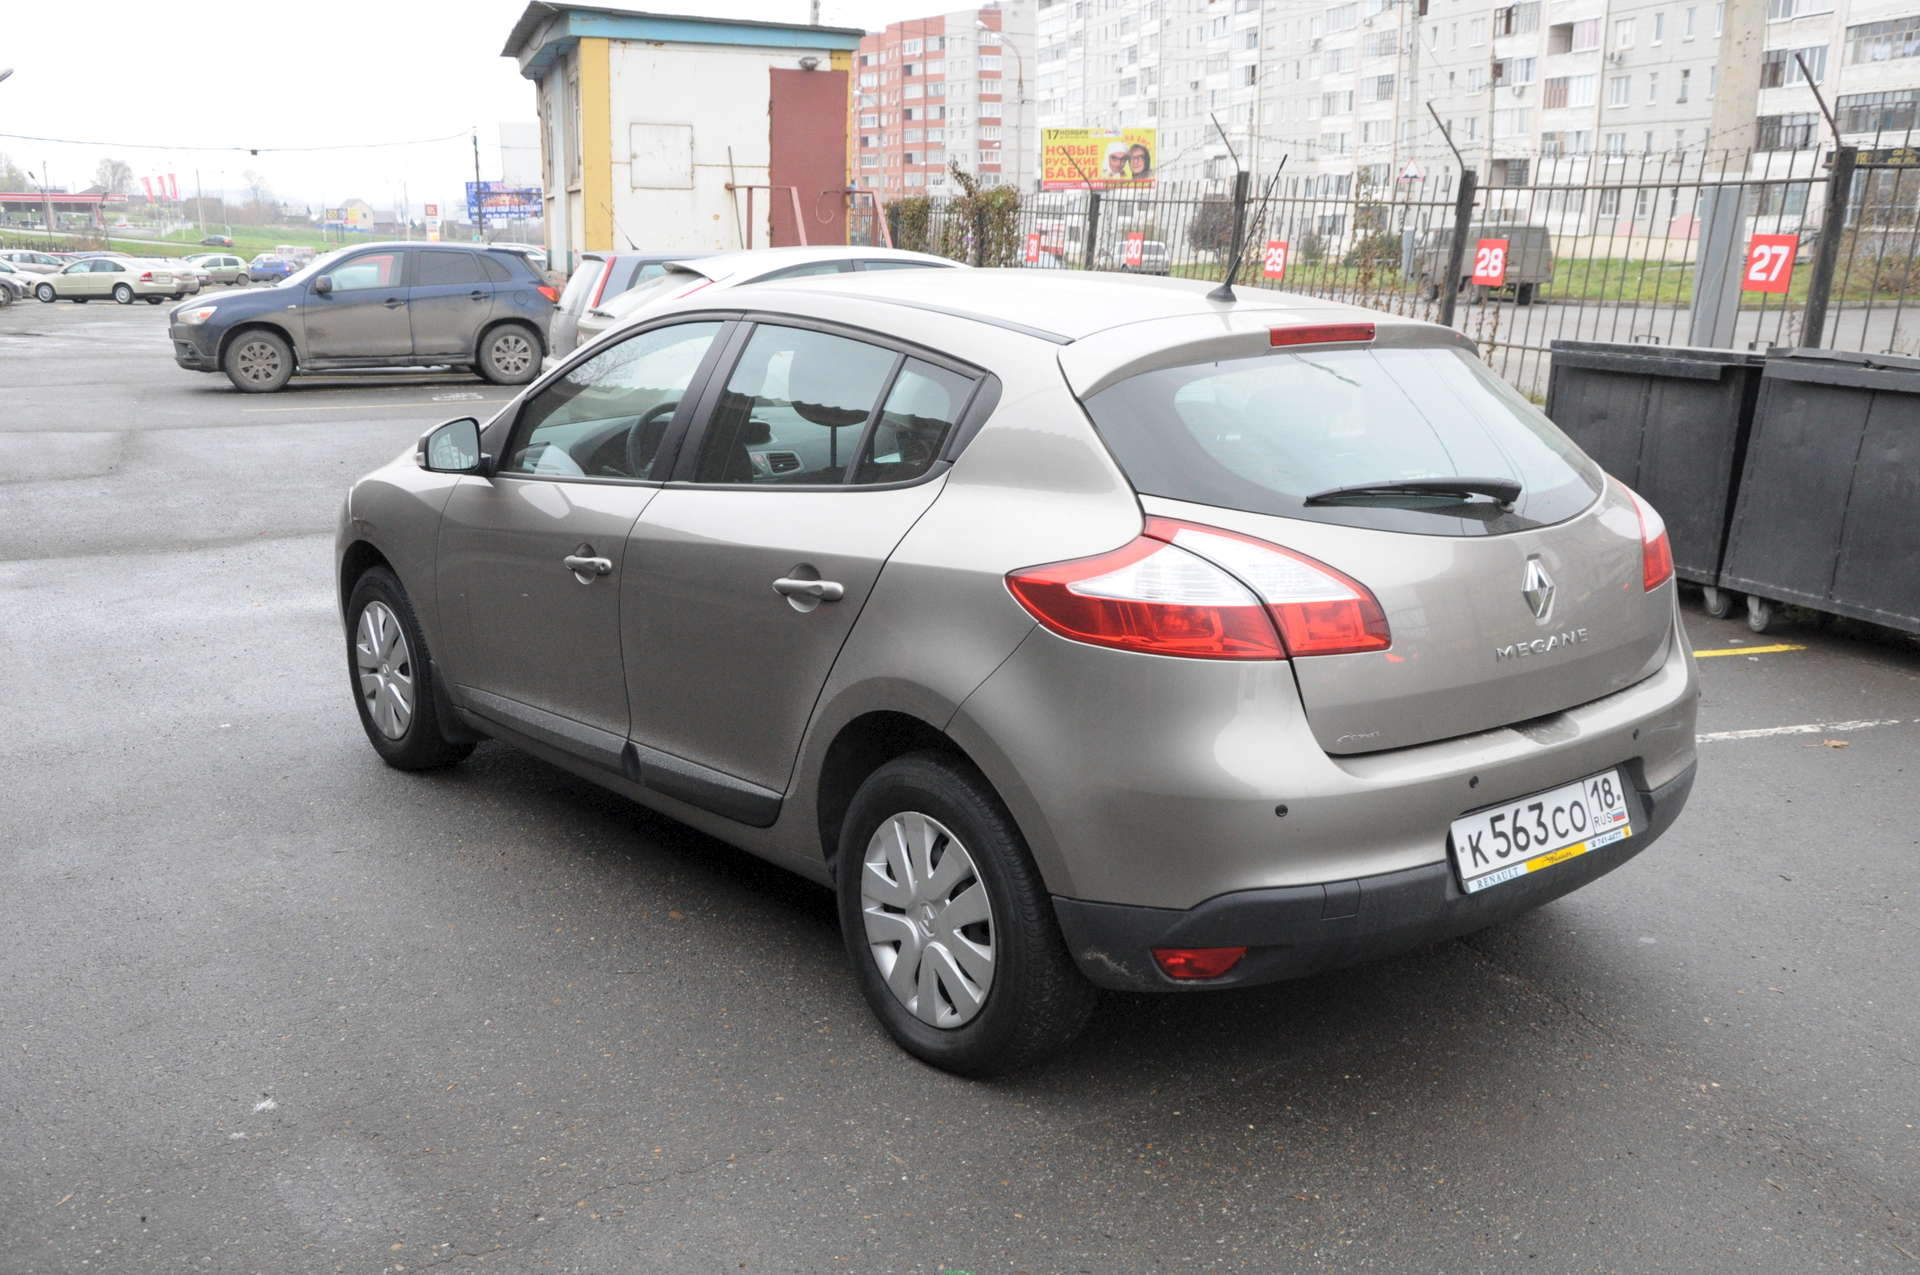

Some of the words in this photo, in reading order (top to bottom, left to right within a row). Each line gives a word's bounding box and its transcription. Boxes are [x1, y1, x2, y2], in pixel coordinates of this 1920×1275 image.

[1047, 129, 1059, 140] 17
[1045, 145, 1098, 156] НОВЫЕ
[1045, 167, 1098, 179] БАБКИ
[1127, 239, 1142, 259] 30
[1266, 248, 1284, 272] 29
[1475, 247, 1504, 278] 28
[1749, 245, 1790, 281] 27
[1496, 627, 1588, 662] MEGANE
[1591, 777, 1615, 812] 18
[1593, 811, 1613, 829] RUS
[1475, 866, 1521, 889] RENAULT
